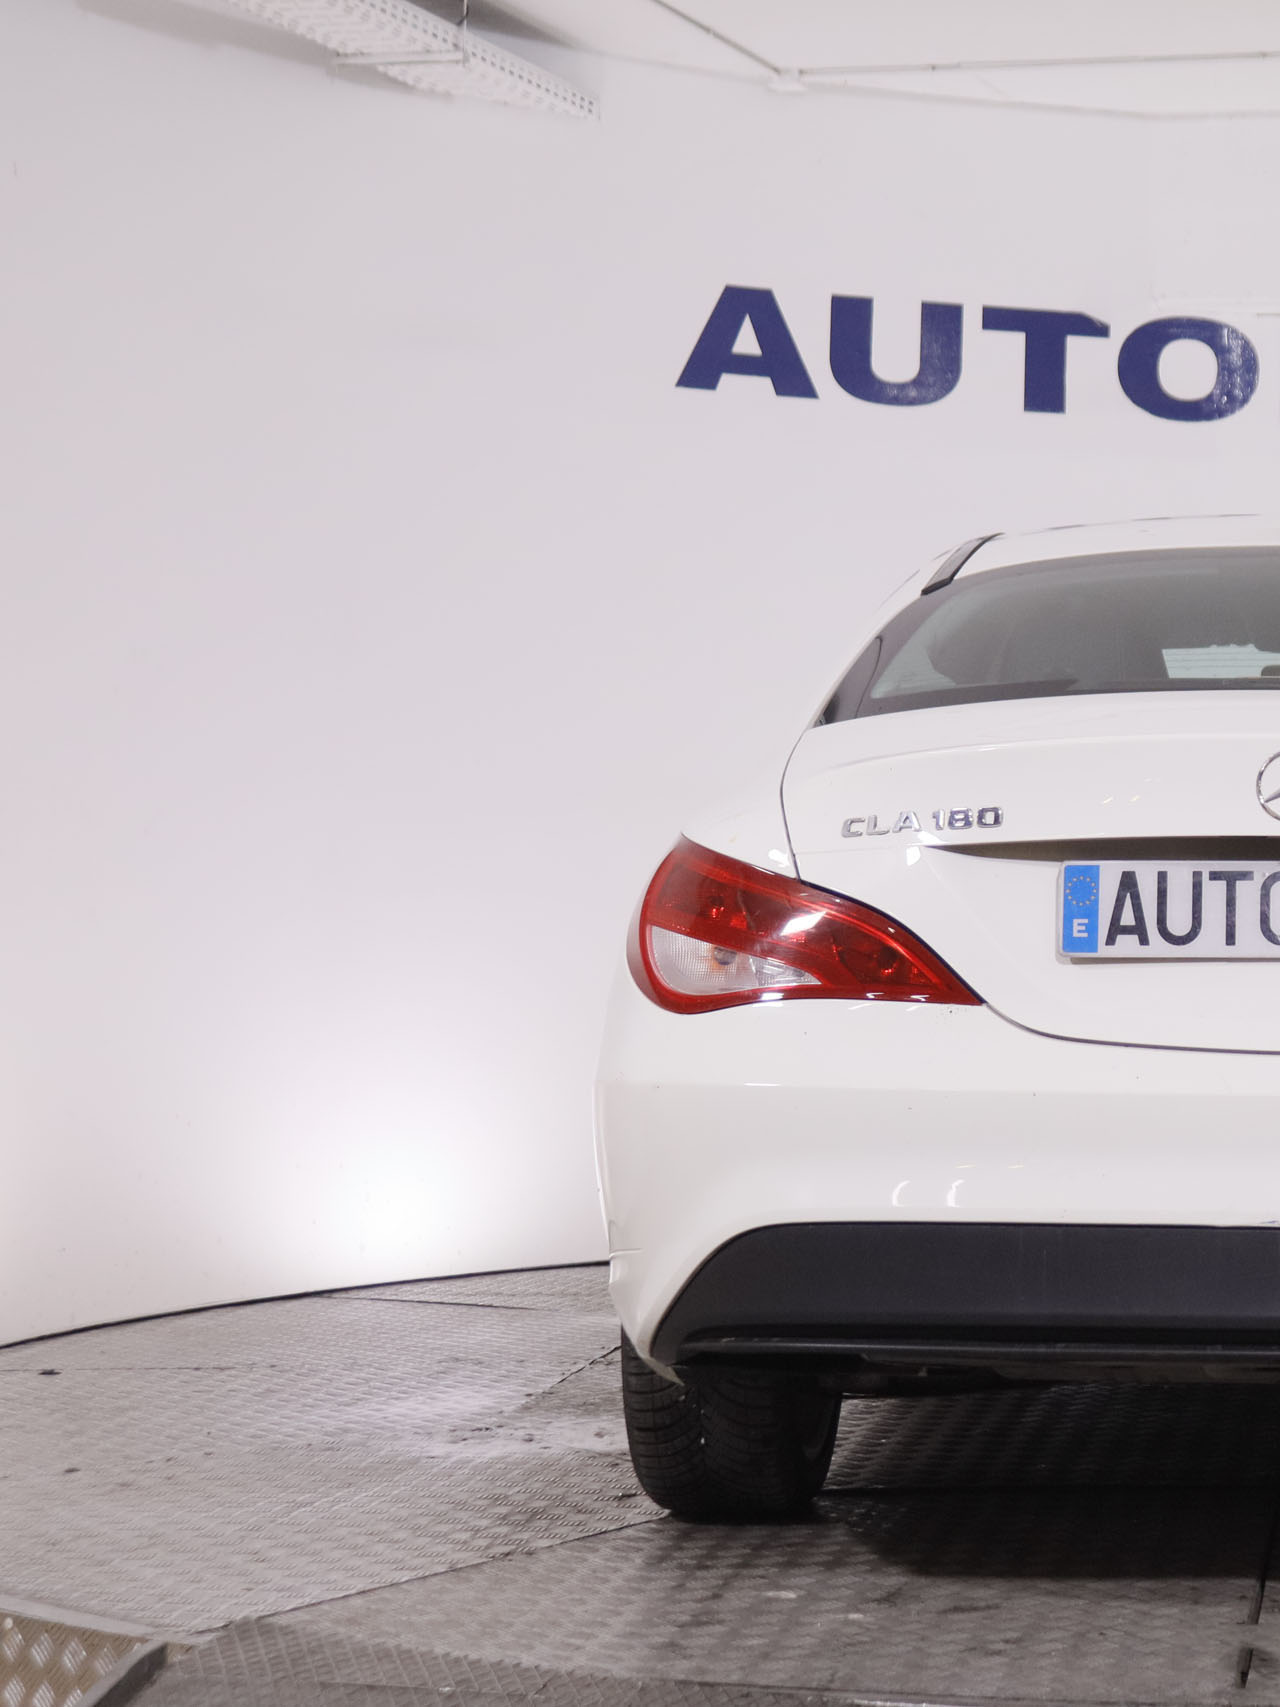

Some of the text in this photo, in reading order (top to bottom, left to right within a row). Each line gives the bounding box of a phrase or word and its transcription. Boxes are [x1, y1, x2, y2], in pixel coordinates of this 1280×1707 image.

[842, 806, 1003, 837] CLA 180
[1073, 919, 1088, 938] E
